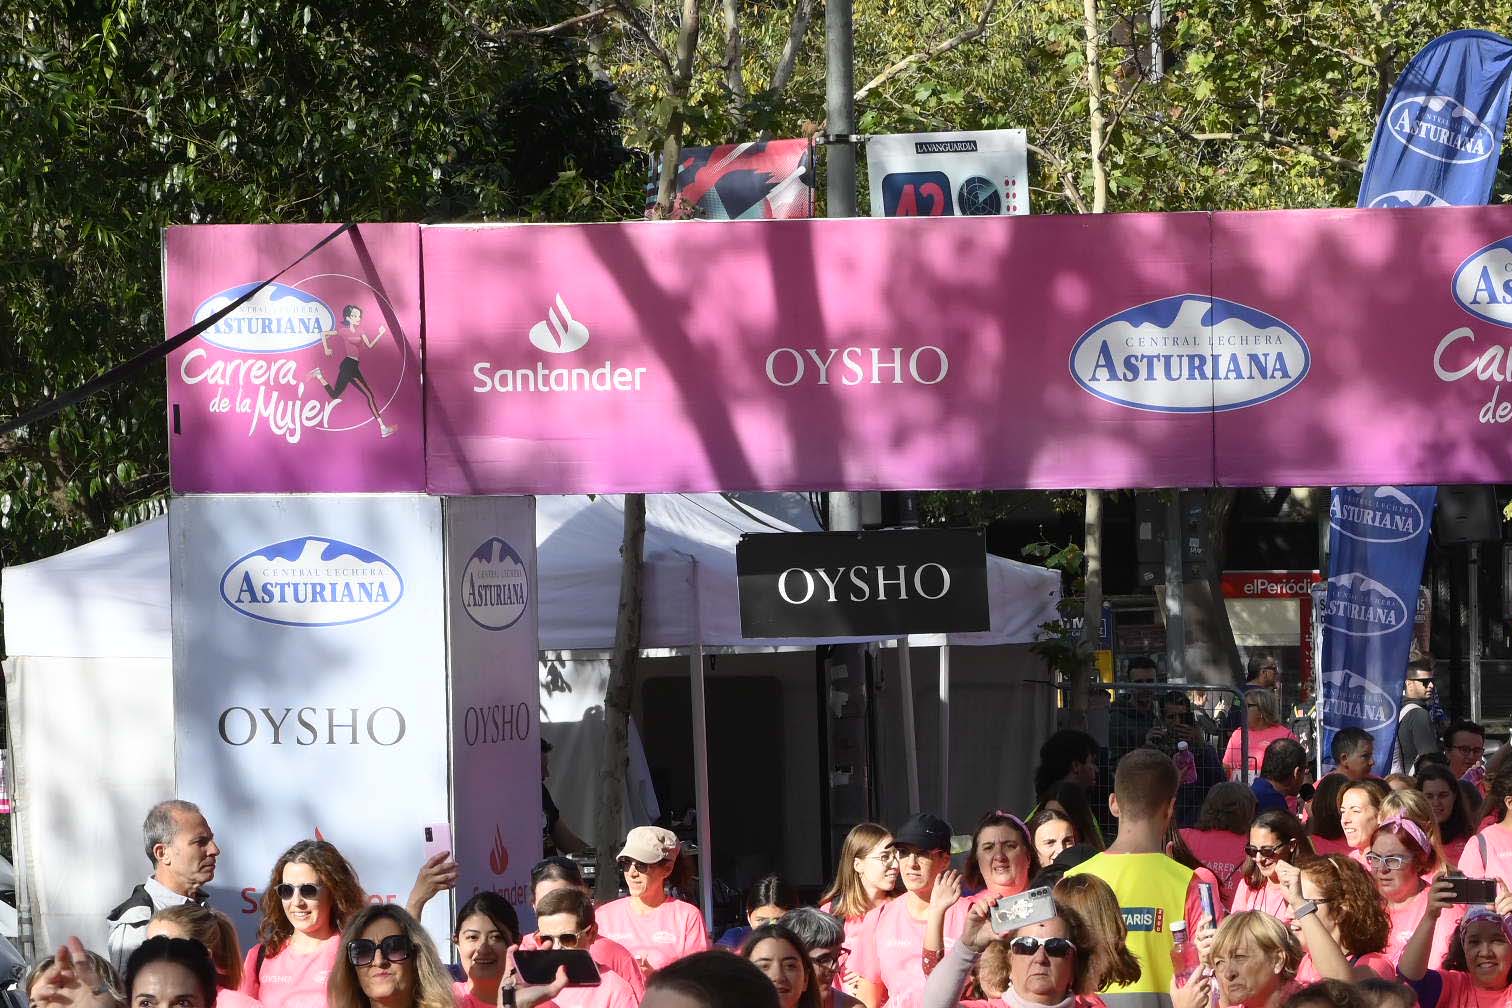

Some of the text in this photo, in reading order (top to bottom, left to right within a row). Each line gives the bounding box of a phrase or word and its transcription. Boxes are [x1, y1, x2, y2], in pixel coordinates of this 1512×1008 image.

[926, 141, 976, 152] VANGUARDIA
[1394, 108, 1484, 154] ASTURIANA
[1125, 334, 1284, 348] CENTRAL LECHERA
[181, 347, 297, 386] Carrera
[473, 360, 647, 393] Santander
[765, 345, 950, 387] OYSHO
[1089, 339, 1292, 383] ASTURIANA
[210, 376, 342, 443] de la Mujer
[1330, 494, 1414, 533] ASTURIANA
[235, 571, 390, 604] ASTURIANA
[262, 567, 385, 577] CENTRAL LECHERA
[467, 572, 526, 608] ASTURIANA
[778, 562, 952, 605] OYSHO
[1328, 599, 1397, 625] STURIANA
[218, 706, 407, 747] OYSHO
[464, 702, 530, 746] OYSHO
